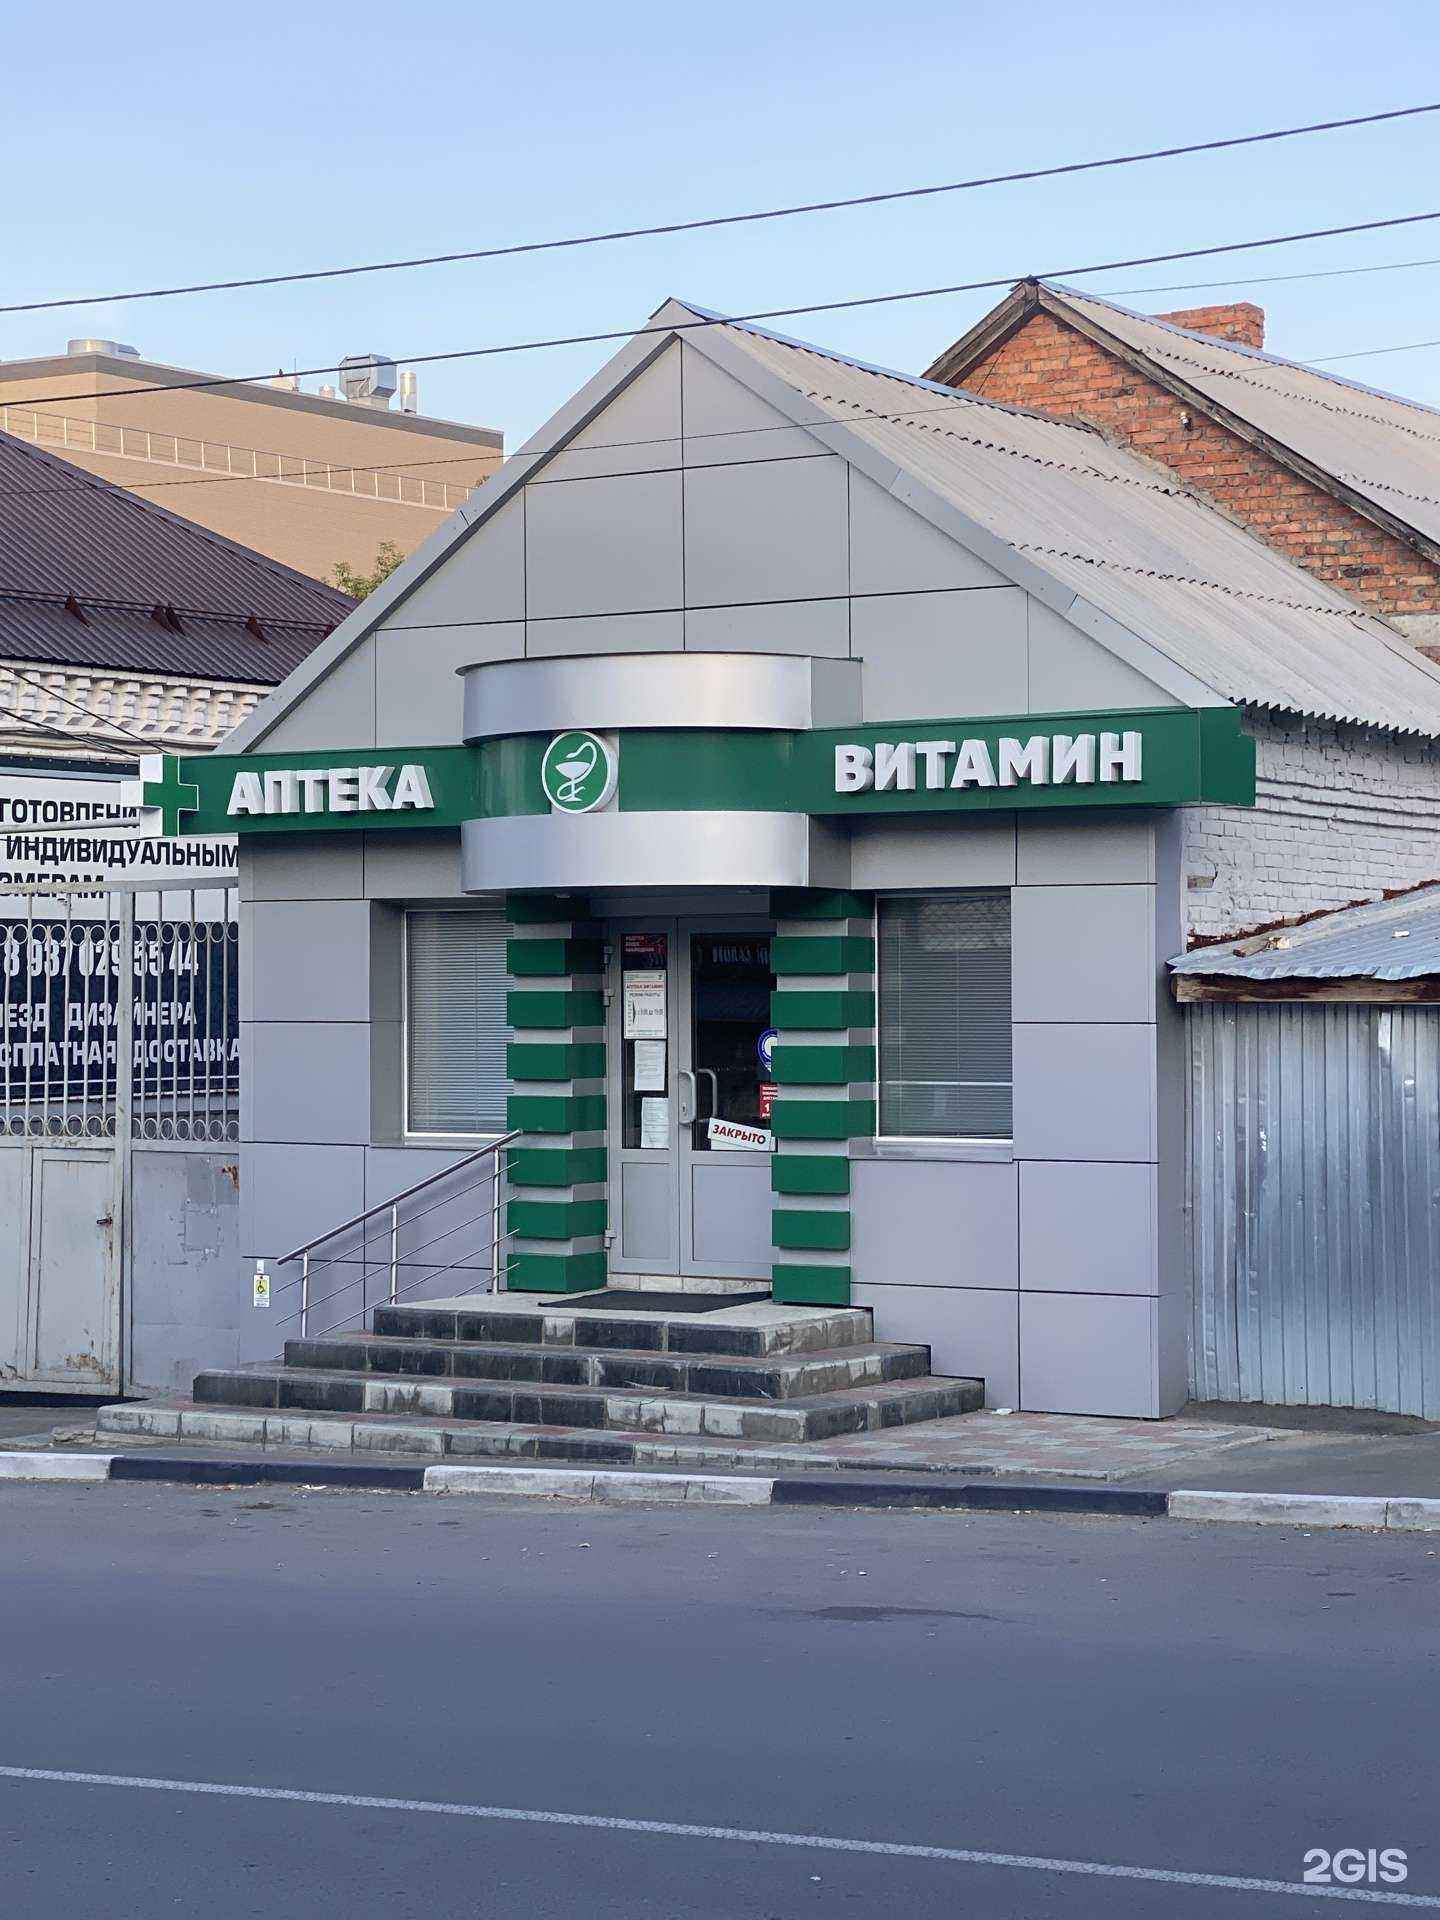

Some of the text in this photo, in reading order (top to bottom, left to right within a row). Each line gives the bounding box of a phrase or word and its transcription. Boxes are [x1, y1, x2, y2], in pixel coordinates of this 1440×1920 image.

[834, 731, 1142, 793] ВИТАМИН
[227, 764, 435, 815] АПТЕКА
[7, 835, 239, 868] ИНДИВИДУАЛЬНЫМ
[4, 939, 20, 977] 8
[133, 940, 164, 977] 55
[168, 940, 199, 976] 44
[0, 1003, 49, 1032] ЕЗД
[712, 1124, 766, 1145] ЗАКРЫТО
